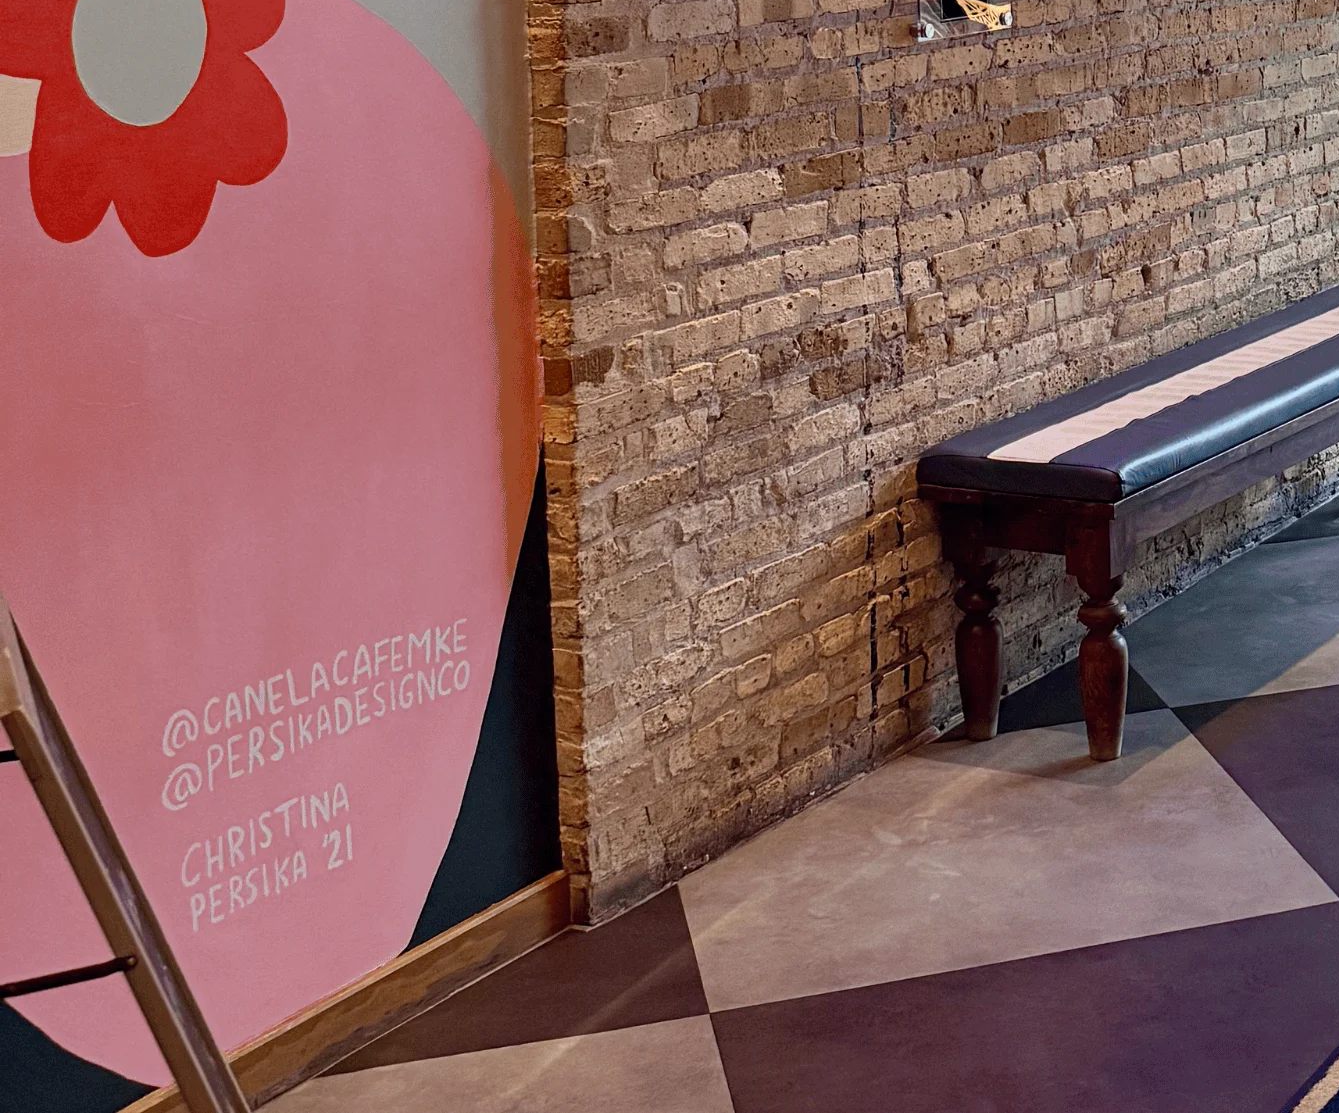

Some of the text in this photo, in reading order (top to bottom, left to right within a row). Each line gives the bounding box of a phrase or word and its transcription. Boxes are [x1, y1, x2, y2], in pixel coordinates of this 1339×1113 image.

[161, 659, 471, 811] @PERSIKADESIGNCO
[162, 618, 468, 757] @CANELACAFEMKE
[181, 782, 350, 887] CHRISTINA
[190, 850, 307, 932] PERSIKA
